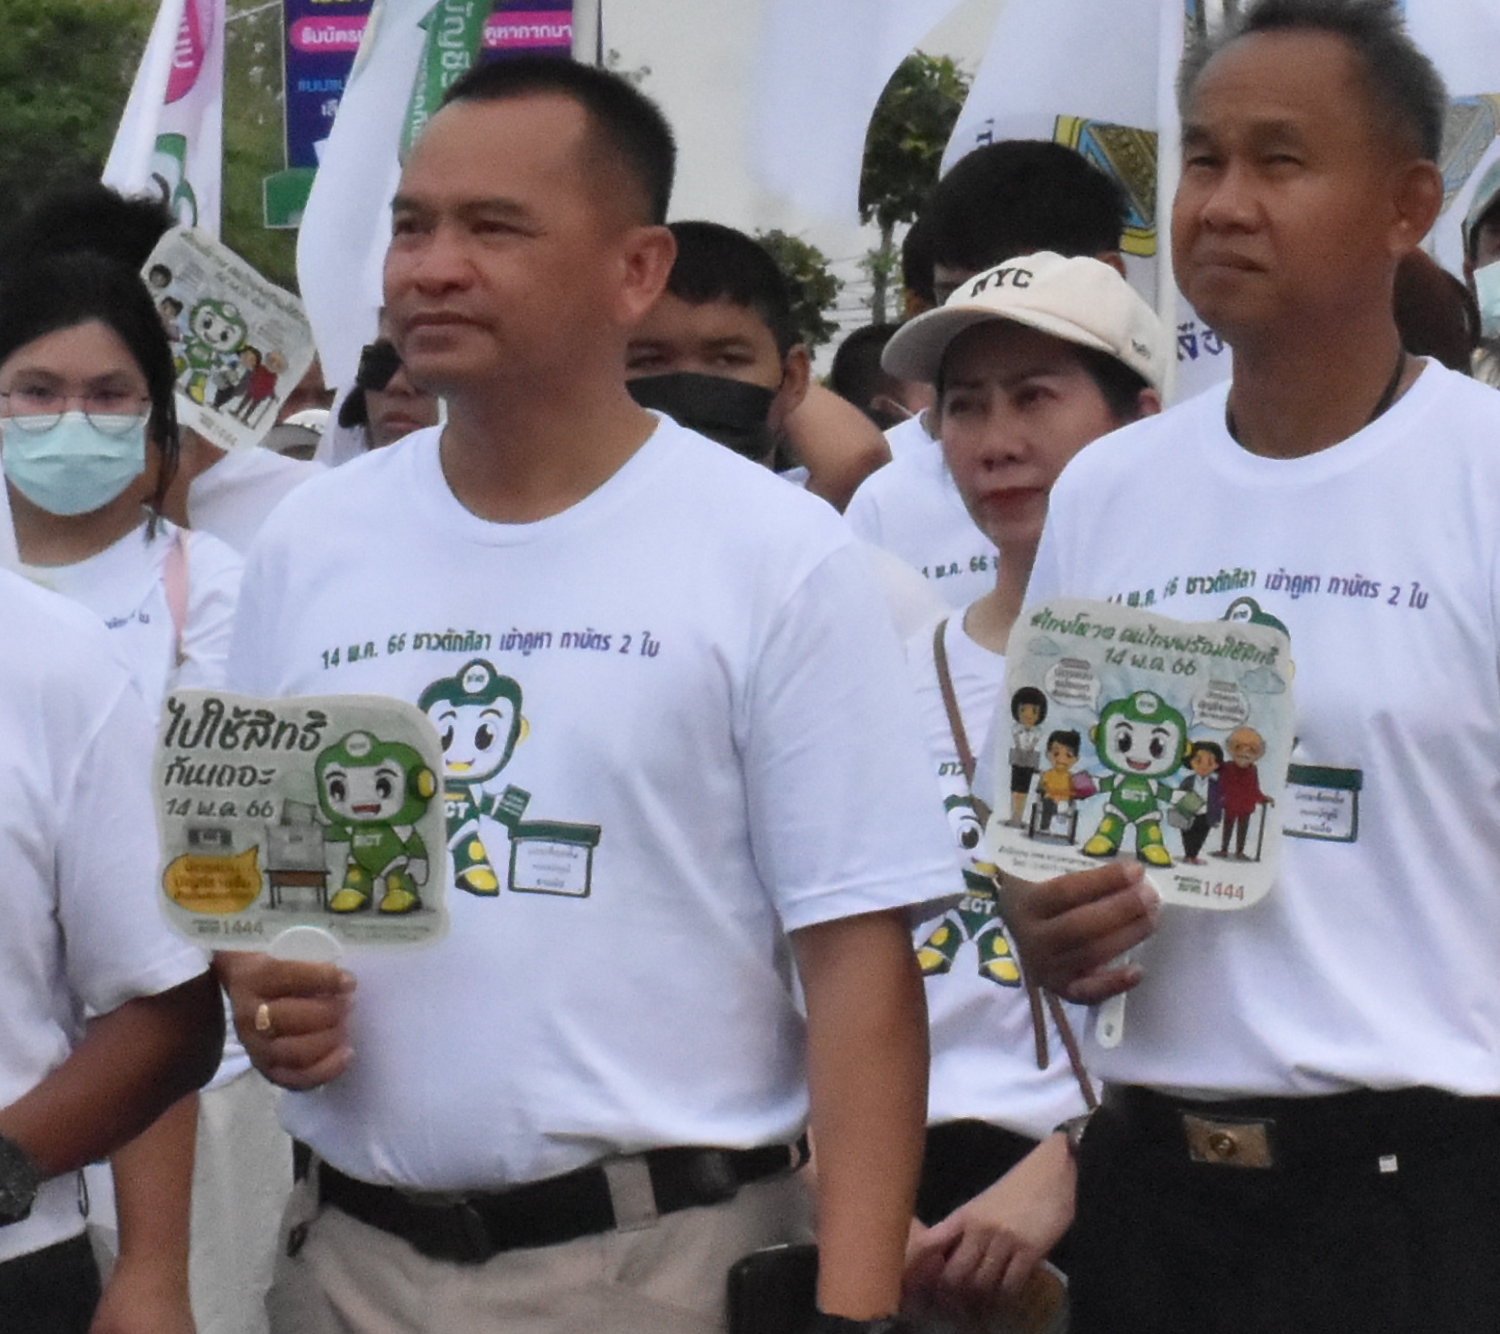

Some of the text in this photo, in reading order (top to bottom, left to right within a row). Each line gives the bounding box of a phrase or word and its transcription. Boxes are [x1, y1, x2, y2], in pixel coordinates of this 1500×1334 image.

[1264, 567, 1320, 602] เข้าคูหา
[1327, 573, 1380, 598] กาบัตร
[1388, 585, 1400, 606] 2
[1410, 581, 1430, 610] ใบ
[321, 649, 340, 670] 14
[387, 631, 408, 653] 66
[412, 628, 492, 654] ชาวตักศิลา
[499, 628, 553, 658] เข้าคูหา
[559, 630, 612, 652] กาบัตร
[618, 635, 631, 654] 2
[641, 630, 661, 660] ใบ
[1104, 646, 1125, 666] 14
[1171, 657, 1197, 677] 66
[164, 696, 328, 751] ไปใช้สิทธิ
[166, 798, 192, 817] 14
[246, 800, 275, 818] 66
[444, 799, 470, 819] CT
[1202, 880, 1245, 902] 1444
